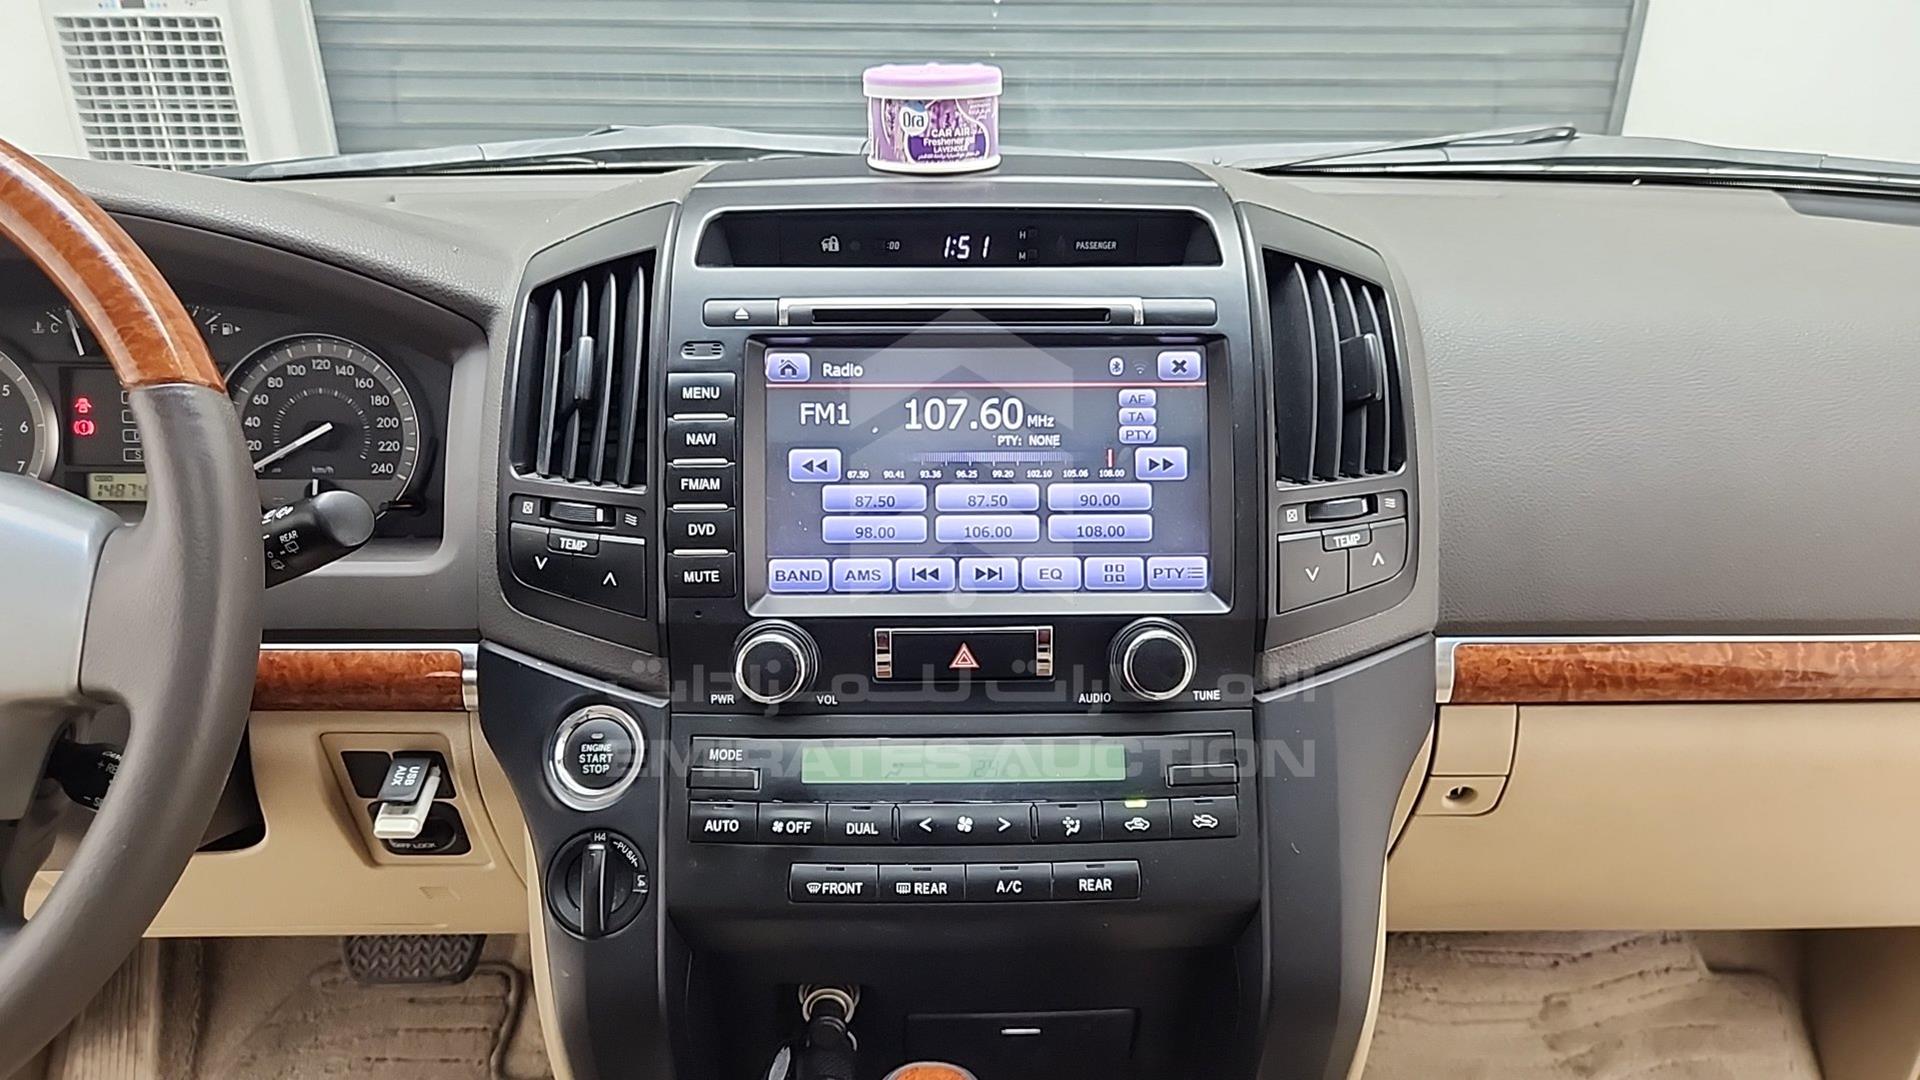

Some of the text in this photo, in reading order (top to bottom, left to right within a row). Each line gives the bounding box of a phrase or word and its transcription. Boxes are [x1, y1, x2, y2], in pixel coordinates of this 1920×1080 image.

[903, 112, 924, 127] Ora
[931, 127, 970, 137] CAR AIR
[923, 137, 964, 146] Freshener
[944, 235, 990, 259] 1:51
[1075, 240, 1117, 250] PASSENGER
[287, 365, 306, 376] 100
[311, 359, 331, 370] 120
[335, 365, 355, 376] 140
[822, 363, 863, 377] Radio
[267, 377, 284, 388] 80
[355, 378, 374, 389] 160
[2, 385, 10, 396] 5
[682, 387, 720, 399] MENU
[252, 394, 269, 405] 60
[370, 395, 390, 406] 180
[800, 402, 850, 425] FM1
[904, 398, 1055, 430] 107.60 MHz
[1128, 411, 1146, 422] TA
[20, 421, 28, 433] 6
[244, 416, 261, 427] 40
[376, 417, 399, 428] 200
[686, 433, 716, 445] NAVI
[997, 434, 1061, 446] PTY: NONE
[1125, 430, 1151, 440] PTY
[246, 440, 262, 451] 20
[378, 440, 400, 451] 220
[17, 461, 26, 472] 7
[371, 463, 394, 474] 240
[883, 470, 905, 479] 90.41
[956, 470, 978, 479] 96.25
[1026, 470, 1053, 479] 102.10
[680, 478, 721, 490] FM/AM
[854, 495, 1121, 508] 87.50 87.50 90.00
[688, 524, 716, 536] DVD
[854, 526, 1126, 539] 98.00 106.00 108.00
[280, 530, 299, 543] REAR
[1333, 533, 1361, 548] TEMP
[559, 537, 588, 551] TEMP
[684, 570, 720, 582] MUTE
[775, 569, 822, 582] BAND
[845, 569, 882, 582] AMS
[1039, 568, 1063, 581] EQ
[1153, 567, 1185, 579] PTY
[710, 694, 735, 705] PWR
[817, 694, 838, 705] VOL
[1078, 692, 1112, 704] AUDIO
[1193, 689, 1221, 701] TUNE
[581, 743, 612, 753] ENGINE
[579, 753, 614, 764] START
[709, 748, 743, 761] MODE
[582, 764, 610, 775] STOP
[404, 766, 420, 786] USB
[704, 819, 740, 833] AUTO
[786, 820, 812, 834] OFF
[846, 822, 879, 835] DUAL
[594, 832, 607, 842] H4
[822, 881, 863, 895] FRONT
[914, 882, 948, 895] REAR
[996, 880, 1022, 893] A/C
[1079, 879, 1112, 892] REAR
